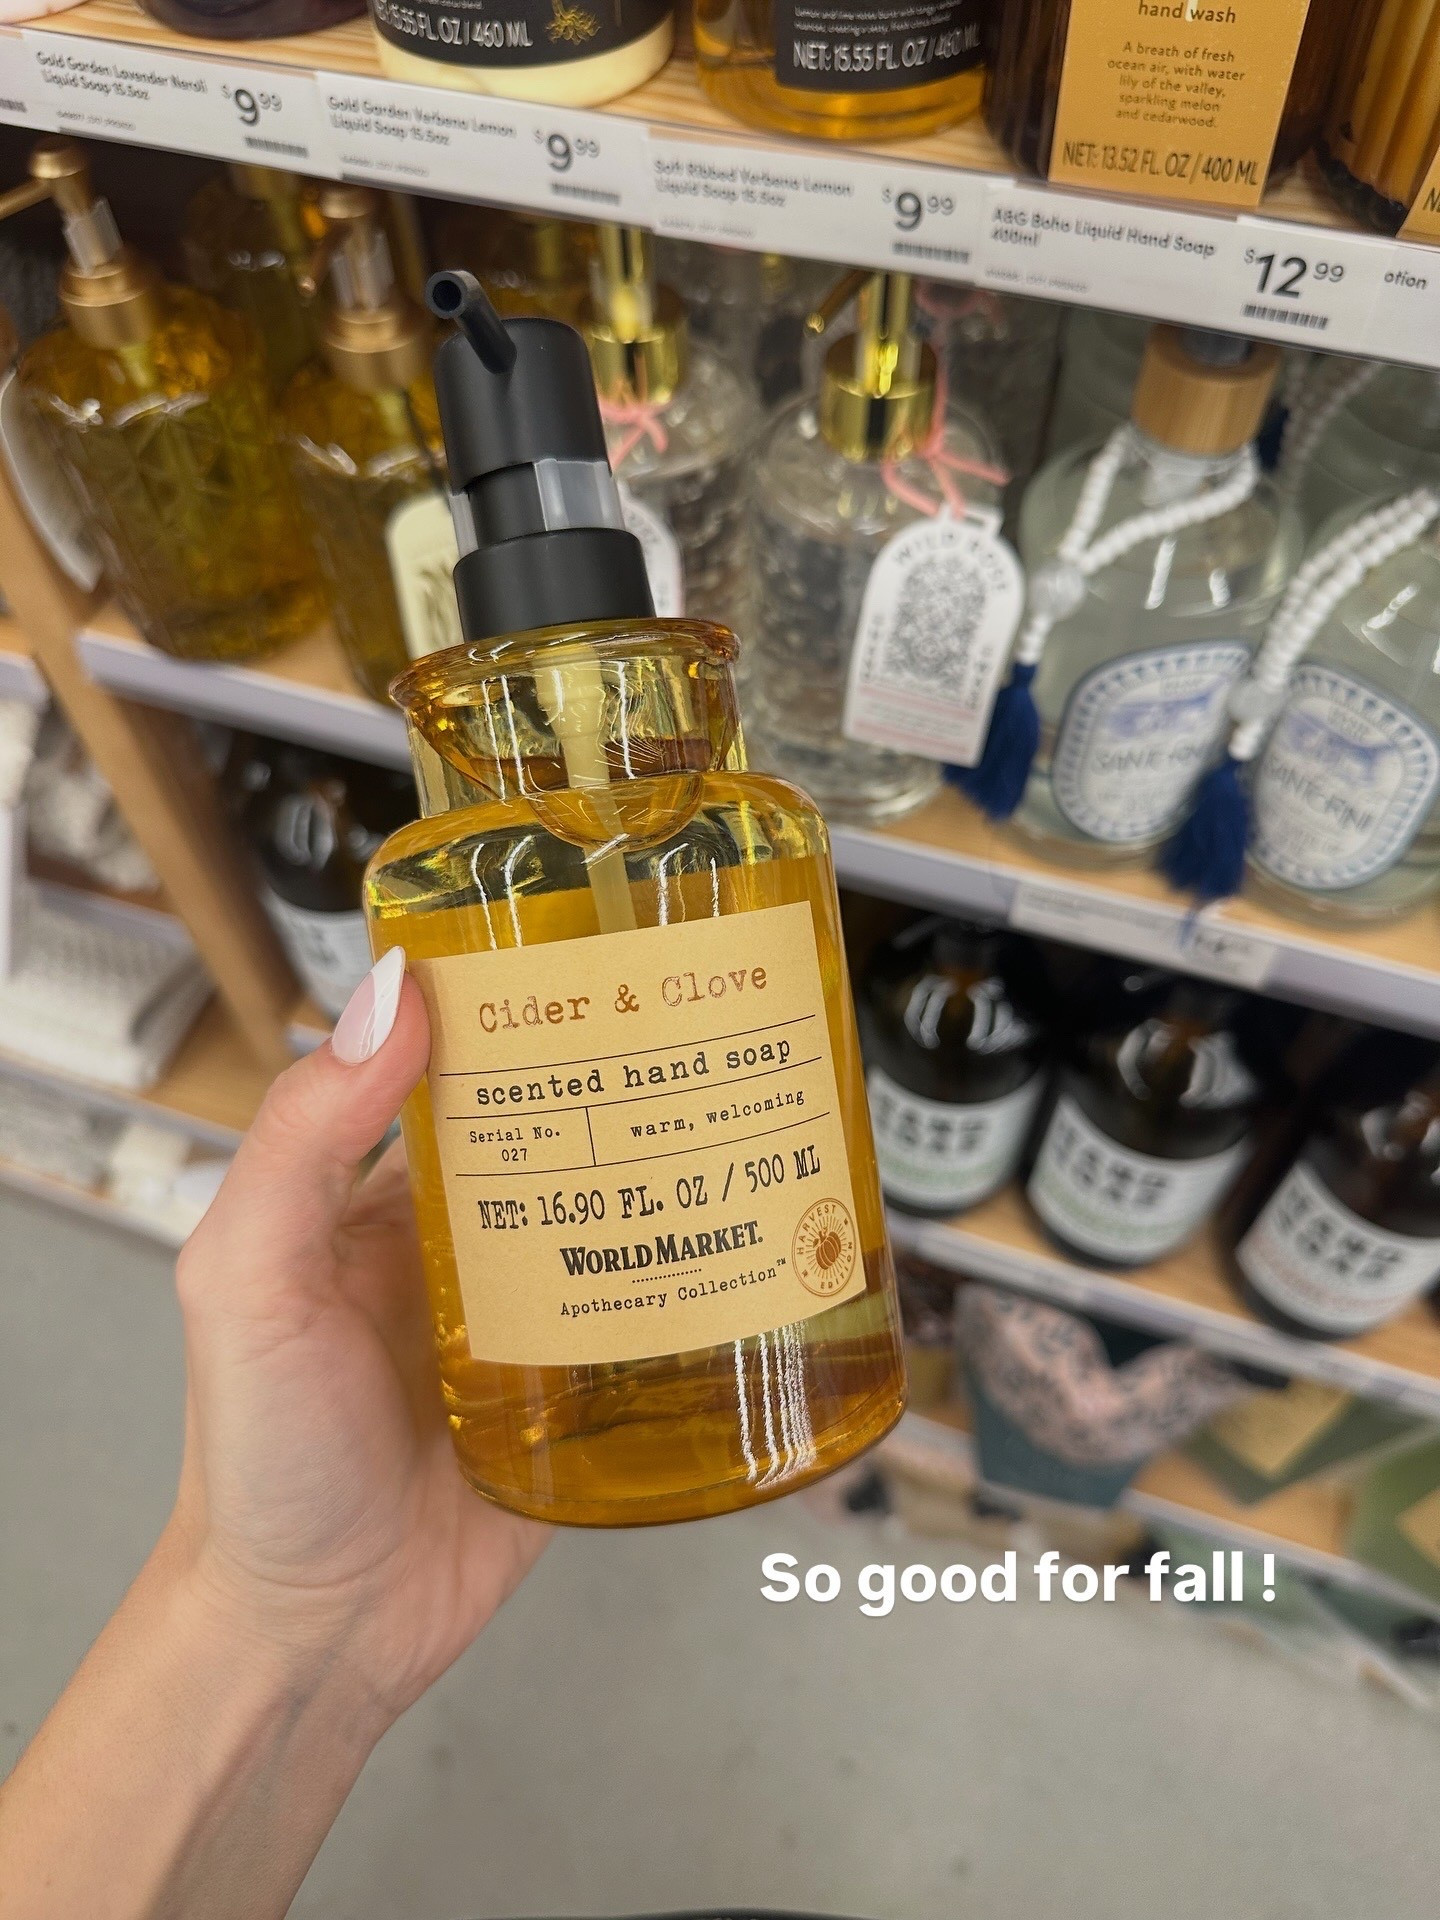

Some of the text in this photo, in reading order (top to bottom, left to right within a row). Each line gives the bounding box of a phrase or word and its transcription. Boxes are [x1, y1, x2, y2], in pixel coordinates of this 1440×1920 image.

[1138, 0, 1236, 24] hand wash
[36, 51, 65, 70] Gold
[834, 42, 874, 72] 15.55
[901, 35, 927, 68] OZ
[1124, 41, 1235, 63] A breath of fresh
[1107, 59, 1247, 82] ocean air, with water
[1119, 74, 1226, 99] lily of the valley,
[328, 95, 360, 114] Gold
[1116, 108, 1139, 121] and
[1118, 92, 1221, 113] sparkling melon
[1102, 143, 1137, 174] 13.52
[1164, 152, 1192, 179] OZ
[1201, 154, 1233, 184] 400
[1234, 158, 1259, 187] ML
[1075, 218, 1122, 244] Liquid
[1126, 227, 1169, 251] Hand
[1173, 234, 1215, 258] Soap
[479, 966, 767, 1033] Cider & Clove
[476, 1038, 791, 1105] scented hand soap
[630, 1089, 805, 1138] warm, welcoming
[469, 1126, 561, 1144] Serial No.
[501, 1148, 528, 1163] 027
[477, 1144, 821, 1230] NET: 16.90 FL. OZ / 500 ML
[796, 1204, 837, 1255] HARVEST
[820, 1241, 853, 1290] EDITION
[560, 1291, 668, 1318] Apothecary
